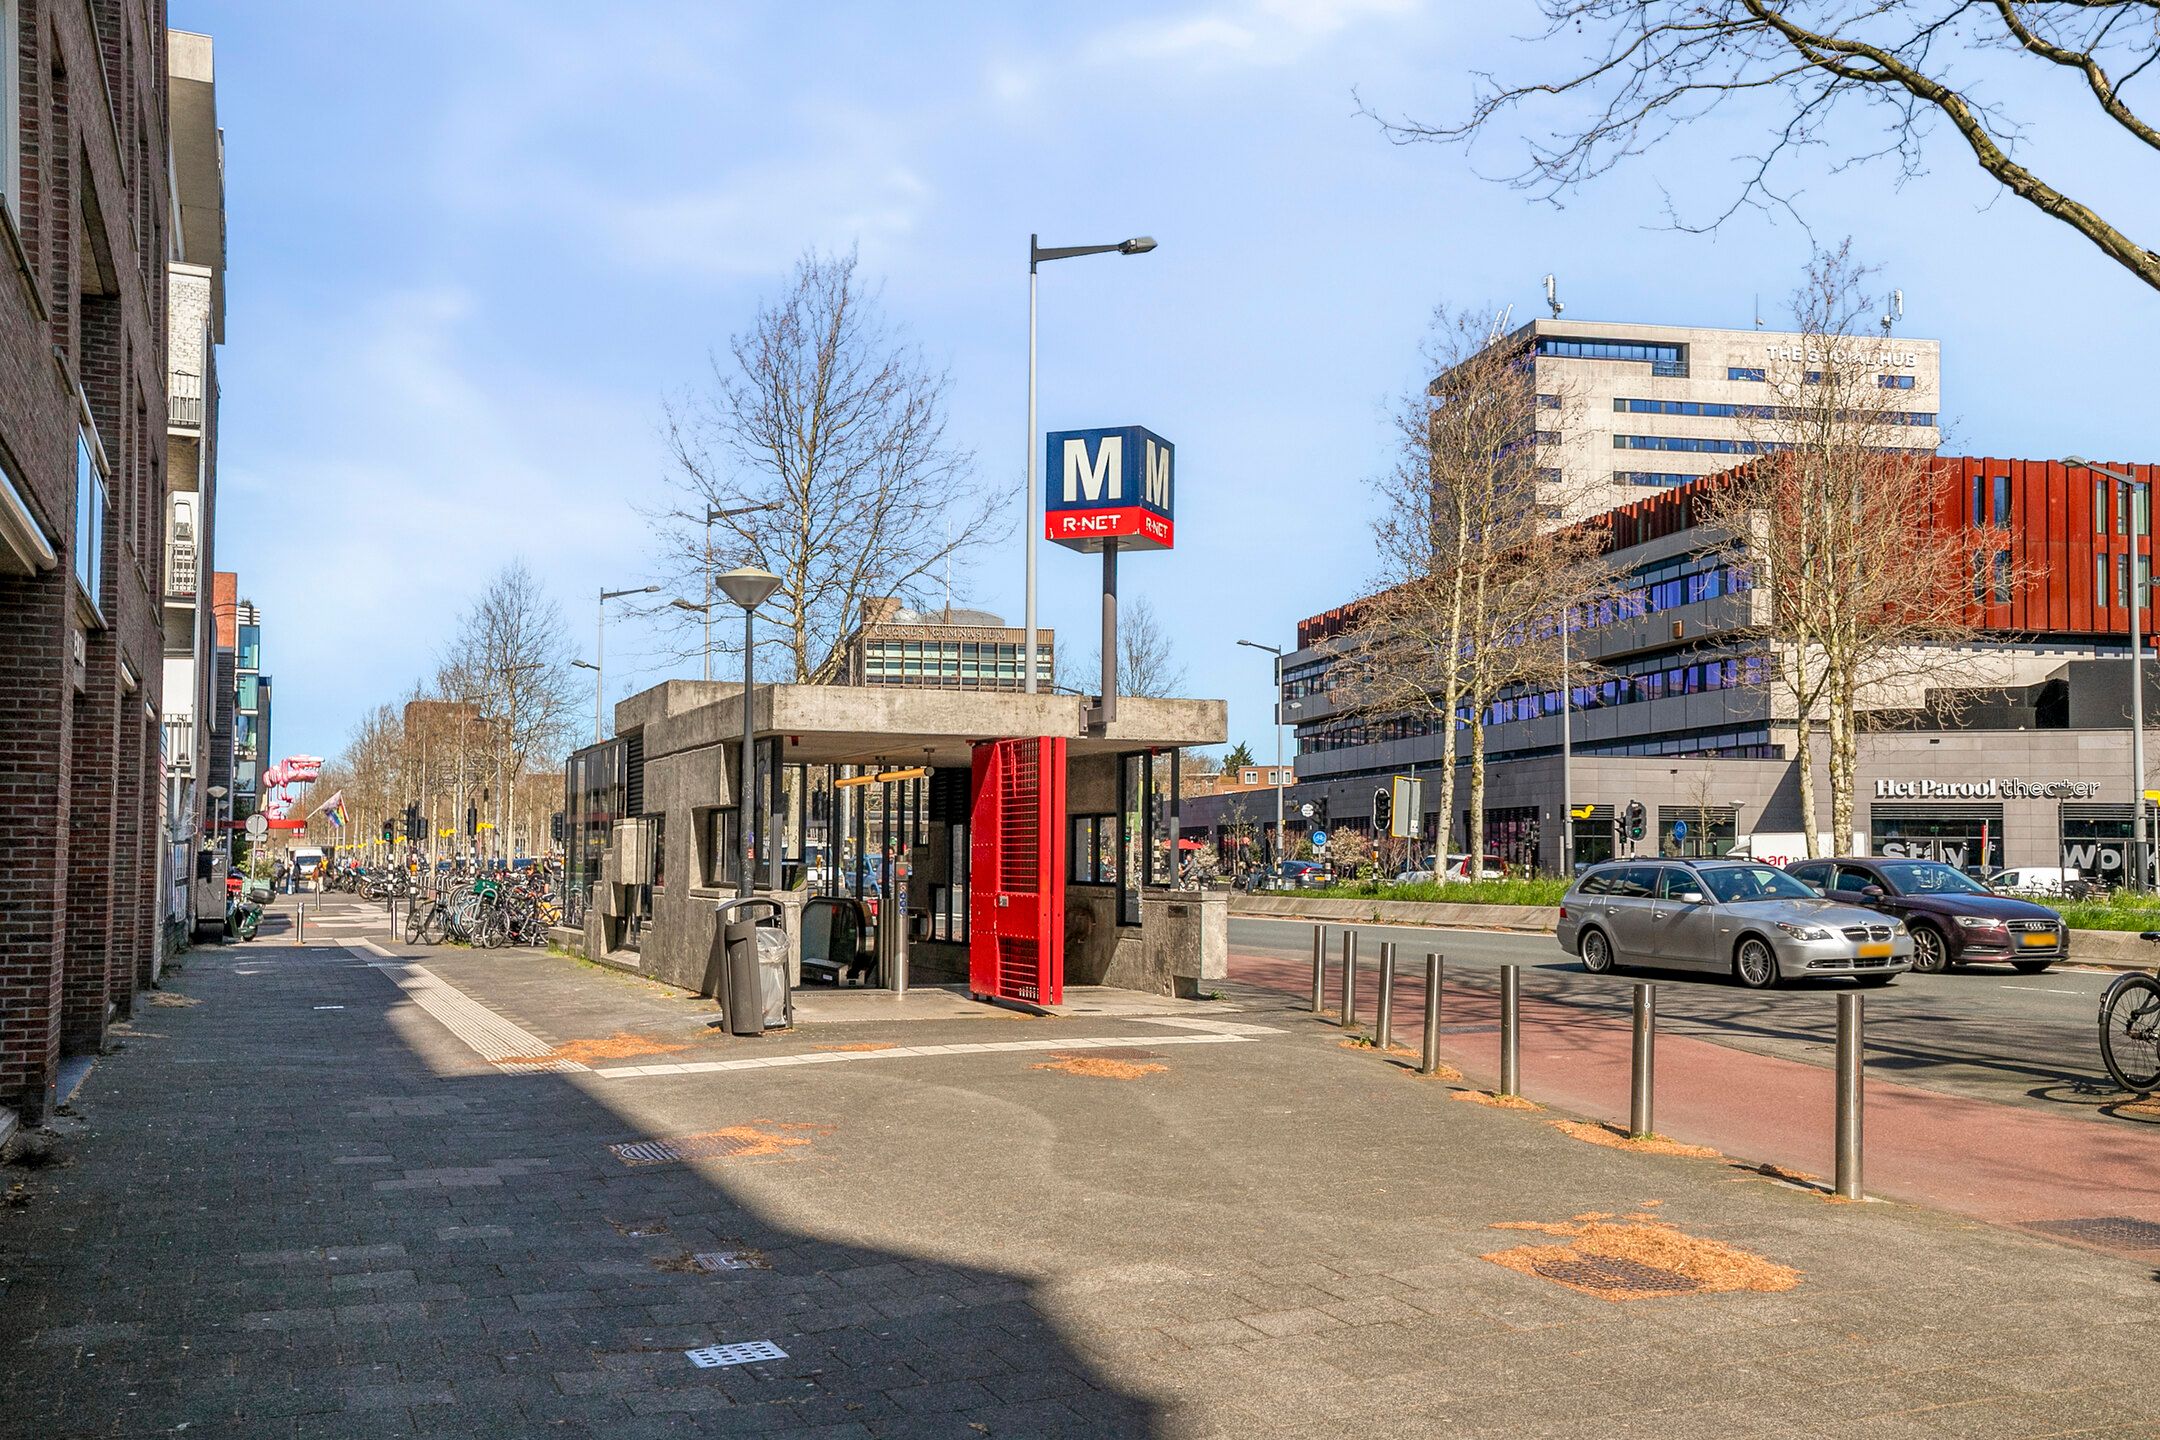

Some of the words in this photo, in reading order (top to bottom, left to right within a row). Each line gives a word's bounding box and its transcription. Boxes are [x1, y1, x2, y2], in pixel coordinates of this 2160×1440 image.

[1767, 345, 1801, 362] THE
[1879, 351, 1918, 368] HUB
[1063, 435, 1123, 502] M
[1145, 438, 1170, 510] M
[1875, 779, 1917, 798] Het
[1920, 778, 1996, 798] Parool
